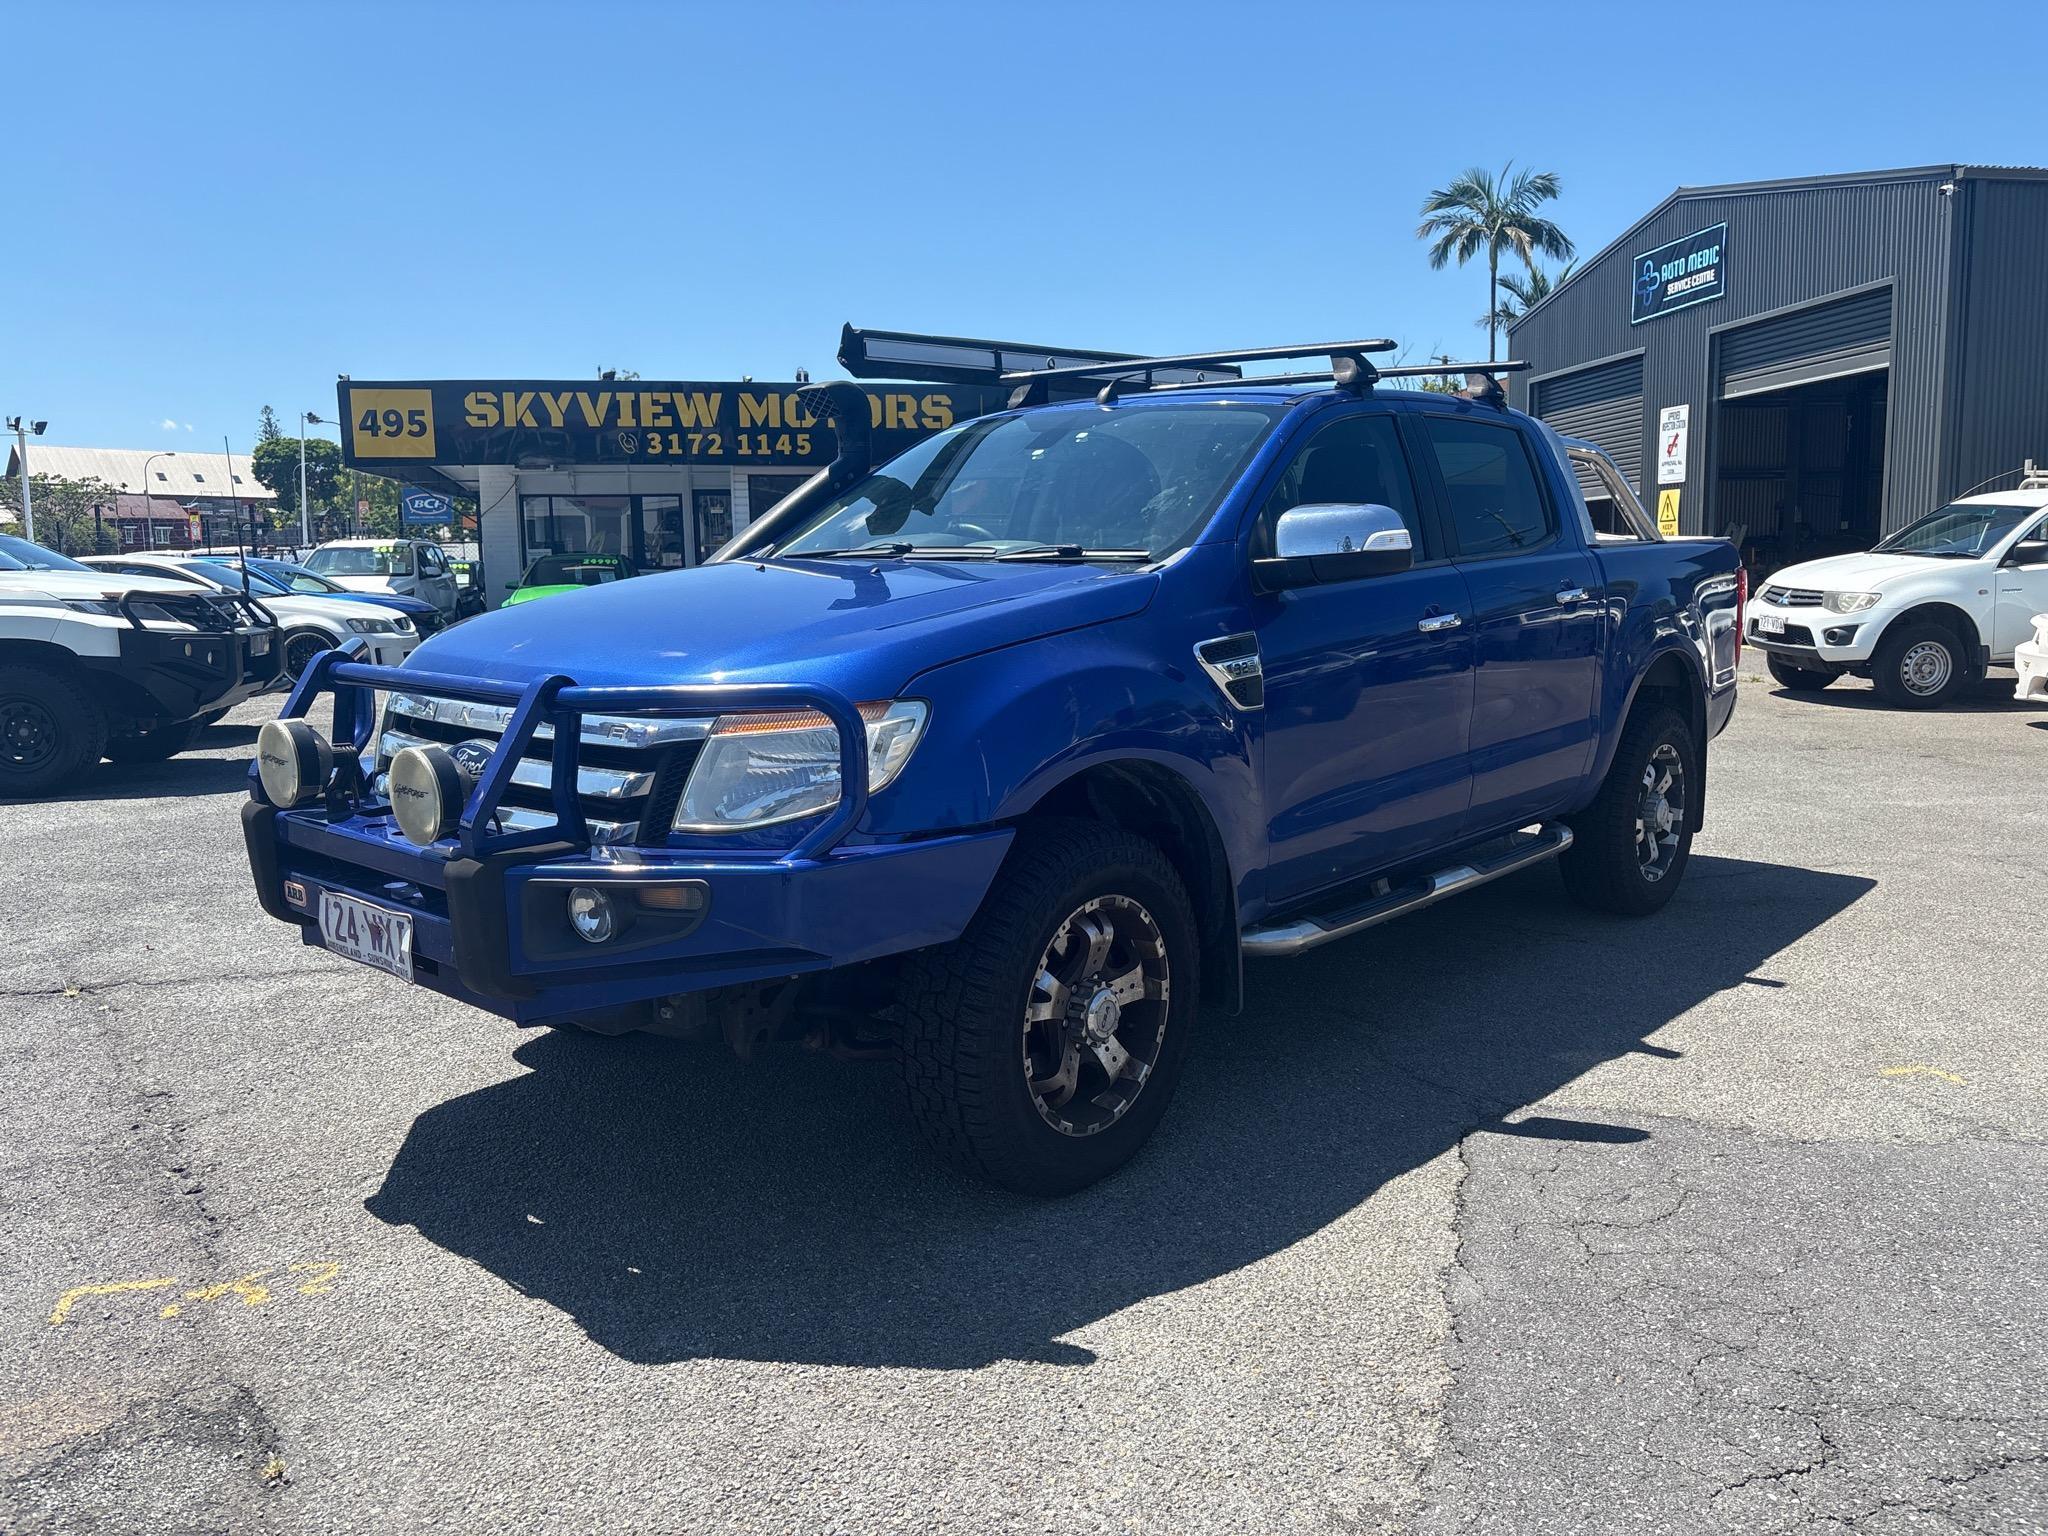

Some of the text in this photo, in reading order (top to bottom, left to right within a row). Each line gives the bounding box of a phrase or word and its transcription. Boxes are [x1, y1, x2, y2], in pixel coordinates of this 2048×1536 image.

[1661, 245, 1720, 282] AUTO MEDIC
[1667, 268, 1715, 295] SERVICE CENTRE
[358, 409, 427, 438] 495
[464, 391, 953, 429] SKYVIEW MORS
[646, 433, 812, 455] 3172 1145
[456, 747, 489, 776] Ford
[287, 885, 304, 902] ARB
